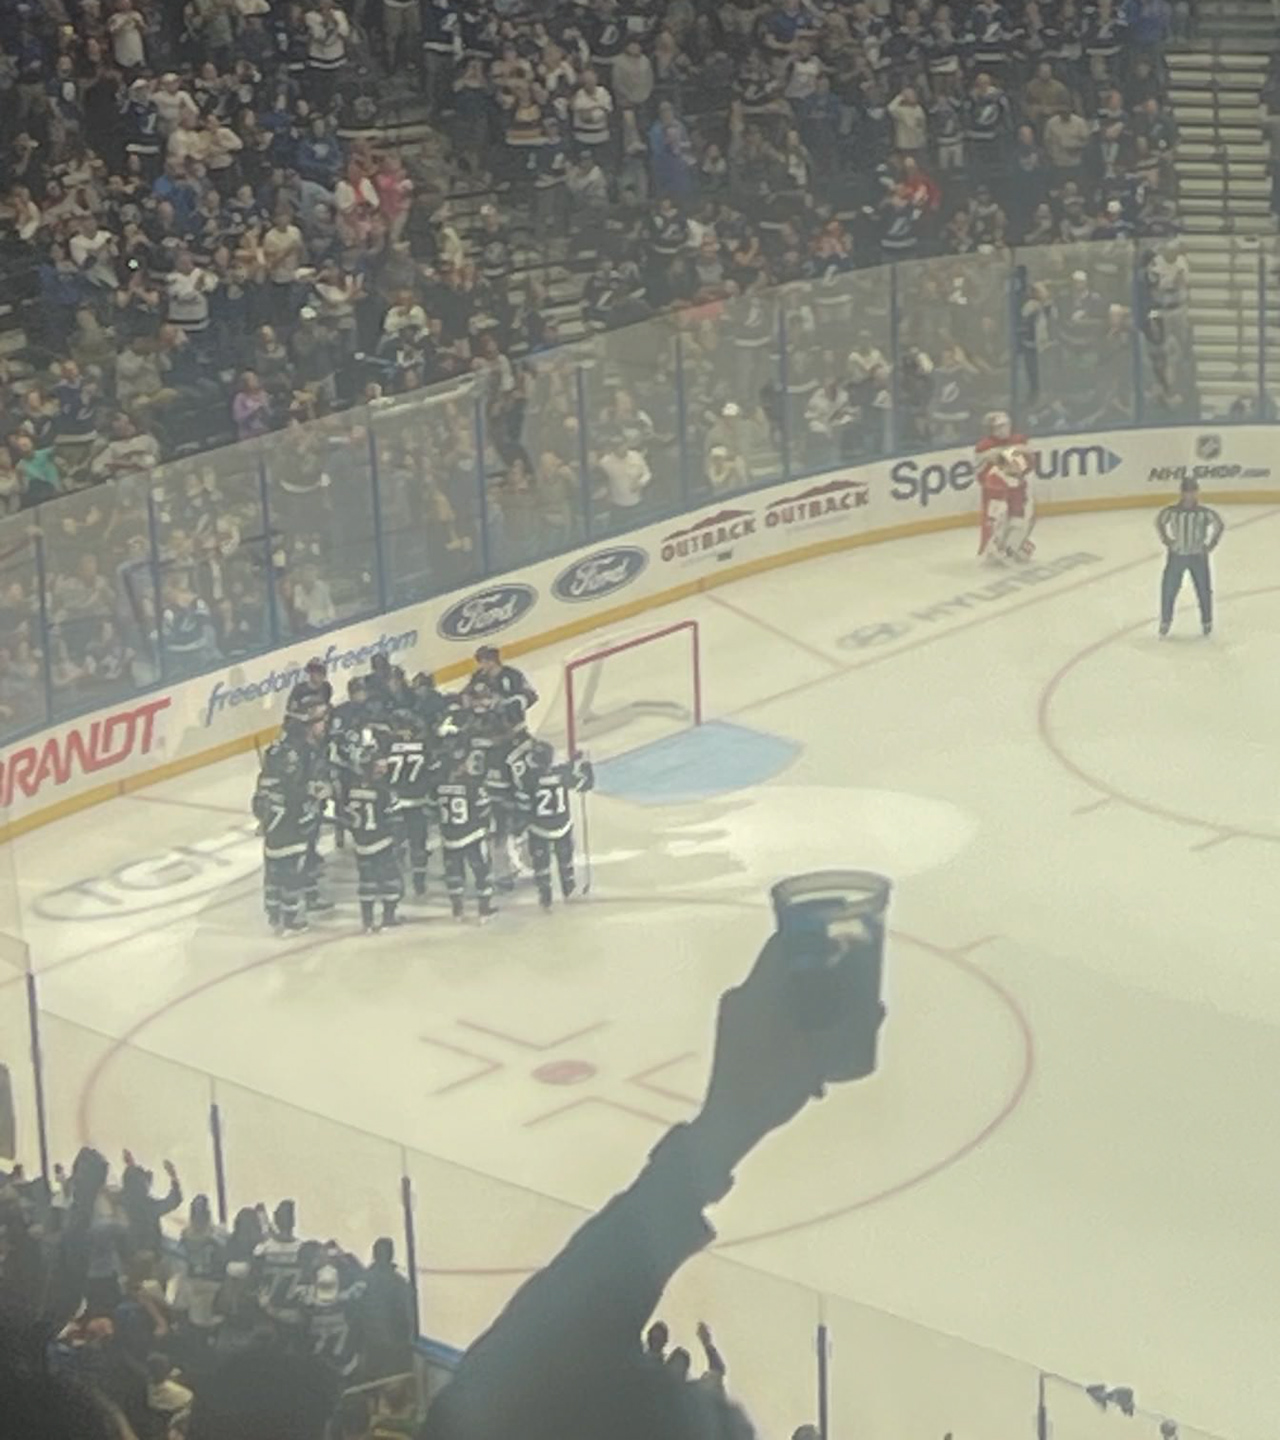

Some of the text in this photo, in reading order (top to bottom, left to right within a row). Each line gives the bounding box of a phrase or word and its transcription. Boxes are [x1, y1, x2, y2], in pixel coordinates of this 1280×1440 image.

[890, 445, 1106, 507] Speum
[765, 488, 869, 528] OUTBACK
[661, 517, 757, 562] OUTBACK
[569, 556, 631, 596] Ford
[456, 593, 519, 635] Ford
[0, 696, 172, 808] RANDT
[387, 754, 425, 784] 77
[536, 786, 566, 816] 21
